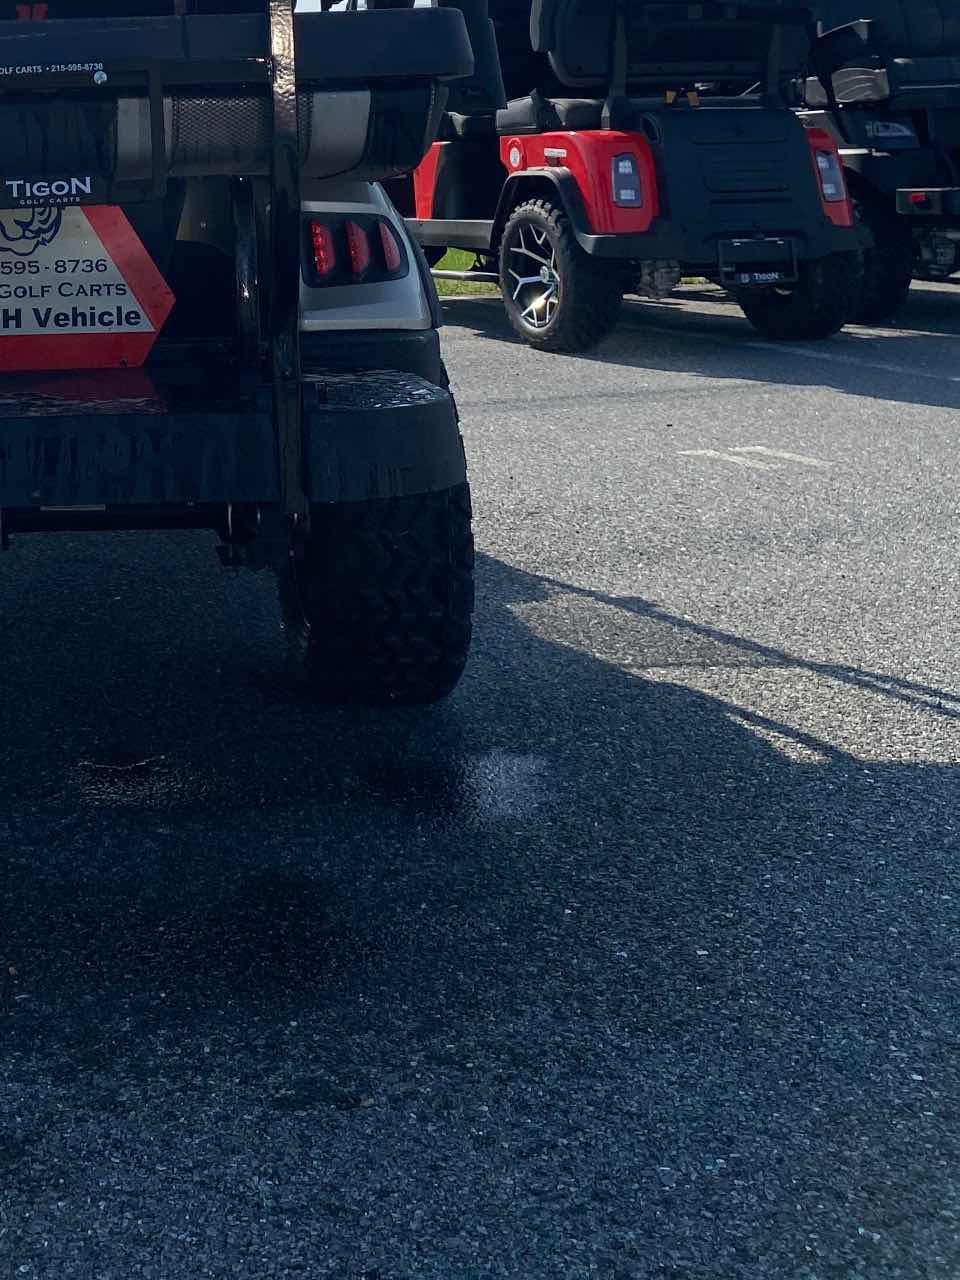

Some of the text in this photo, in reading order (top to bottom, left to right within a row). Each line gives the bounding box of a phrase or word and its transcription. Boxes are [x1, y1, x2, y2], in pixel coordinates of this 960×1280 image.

[15, 65, 42, 74] CARTS
[6, 176, 91, 198] TIGON
[49, 196, 81, 204] CARTS
[58, 282, 127, 297] CARTS
[32, 305, 141, 328] Vehicle
